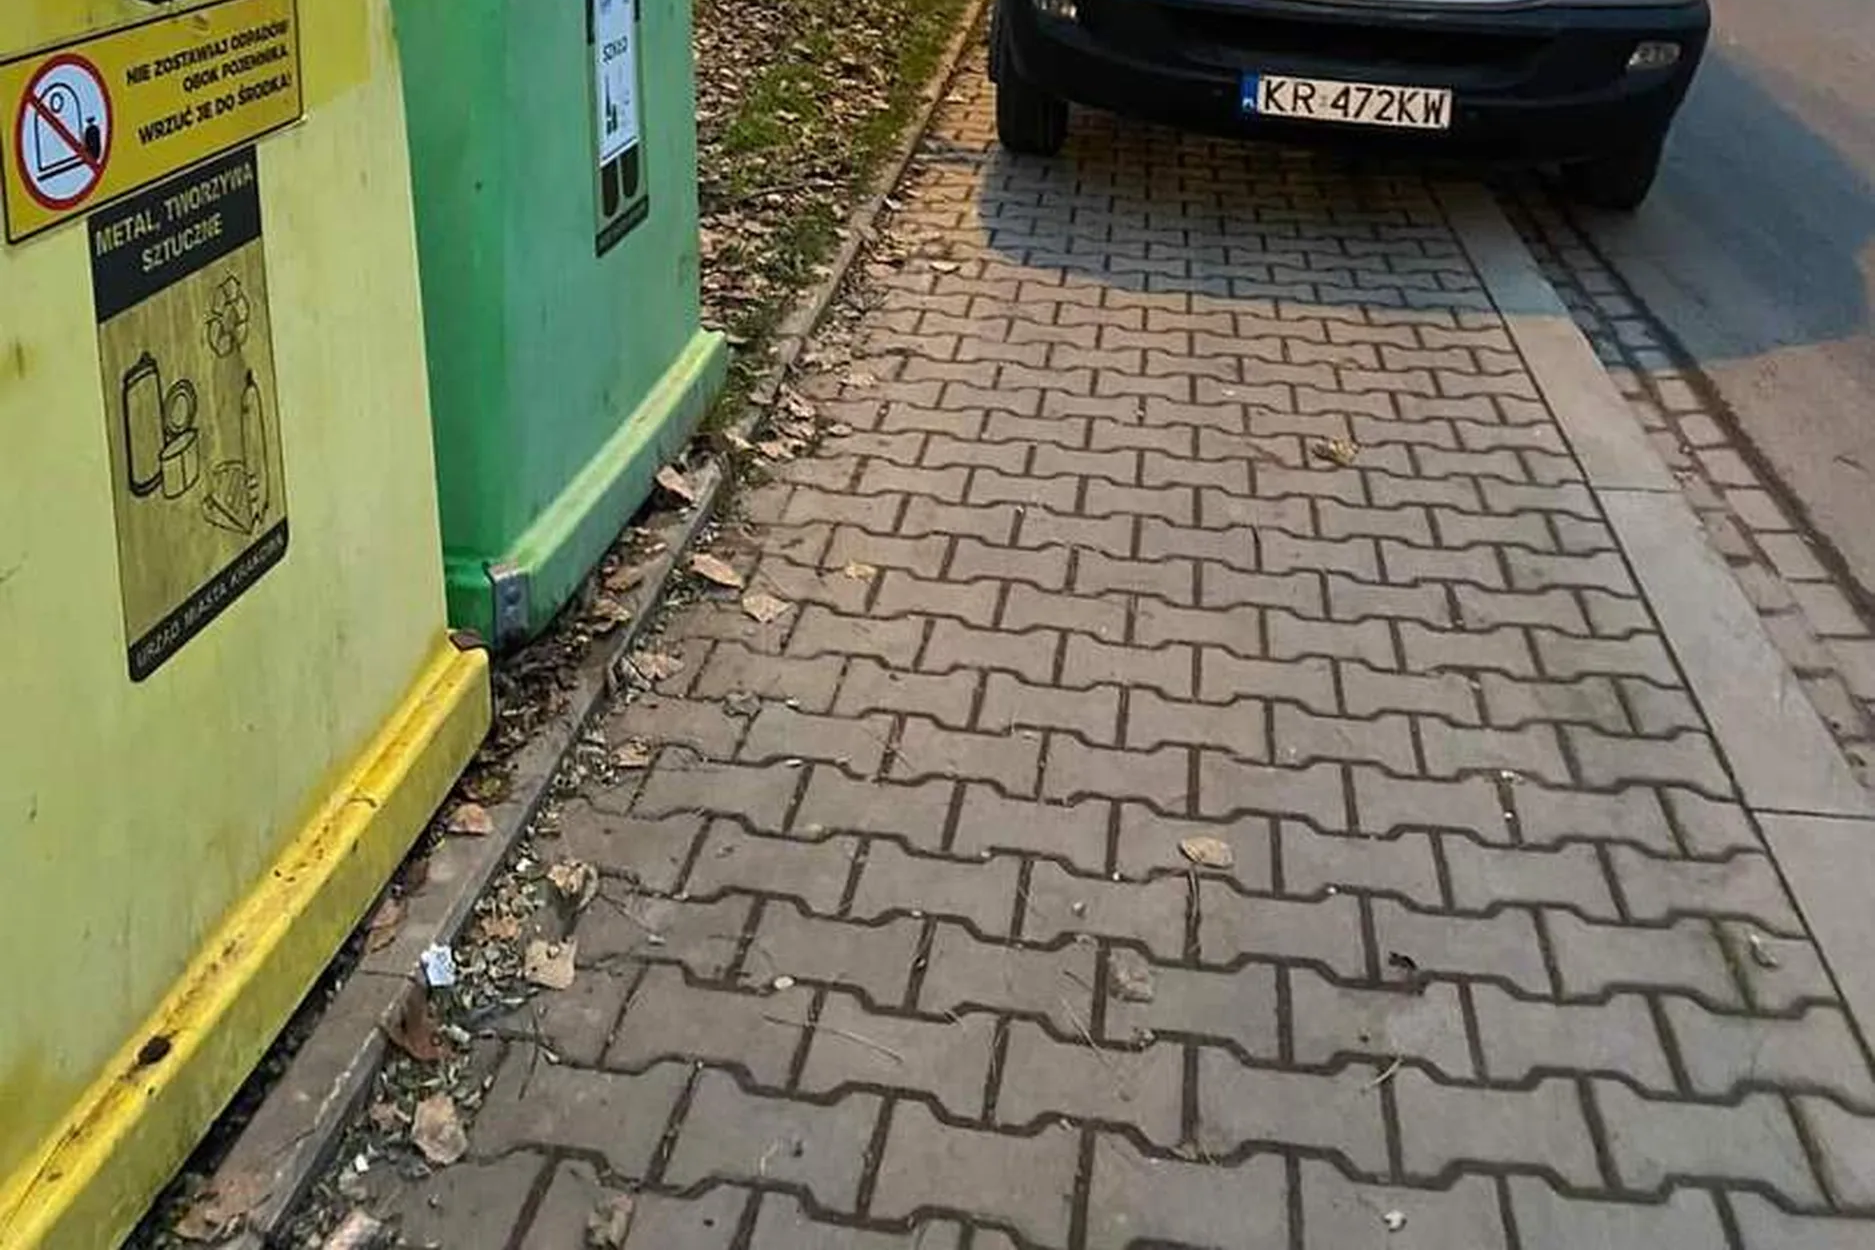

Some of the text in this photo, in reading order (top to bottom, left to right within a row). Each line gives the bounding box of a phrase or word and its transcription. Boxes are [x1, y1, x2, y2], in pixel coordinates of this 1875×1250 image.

[126, 64, 151, 86] NIE
[182, 68, 219, 92] OBOK
[137, 105, 194, 145] WRZUĆ
[196, 102, 213, 123] JE
[214, 94, 234, 115] DO
[1264, 79, 1445, 124] KR 472KW
[95, 162, 253, 257] METAL, TWORZYWA
[141, 212, 224, 273] SZTUCZNE
